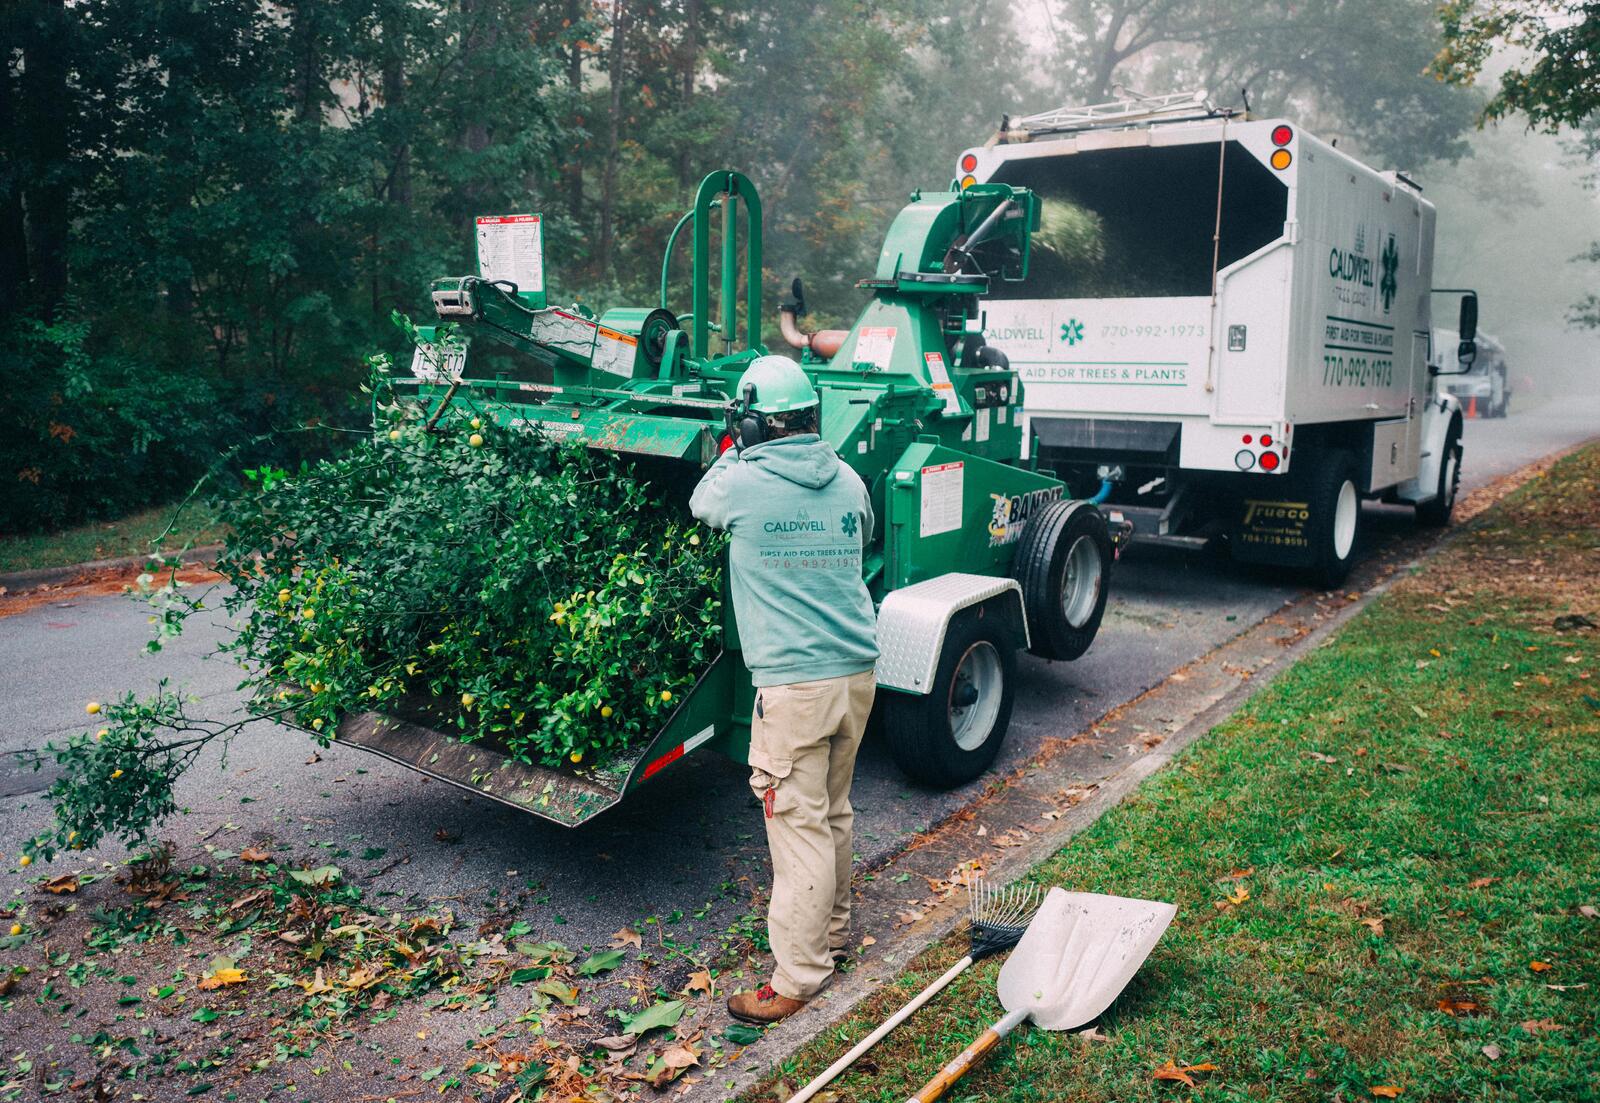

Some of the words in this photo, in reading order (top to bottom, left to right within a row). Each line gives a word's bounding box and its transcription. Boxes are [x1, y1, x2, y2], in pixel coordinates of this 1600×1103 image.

[1329, 248, 1373, 287] CALDWELL
[1026, 368, 1046, 378] AID
[1051, 368, 1075, 378] FOR
[1080, 368, 1117, 379] TREES
[1121, 369, 1130, 379] &
[1136, 369, 1186, 380] PLANTS
[763, 520, 826, 533] CALDWELL
[760, 550, 781, 558] FIRST
[783, 550, 798, 558] AID
[799, 550, 815, 558] FOR
[816, 549, 837, 557] TREES
[837, 548, 843, 556] &
